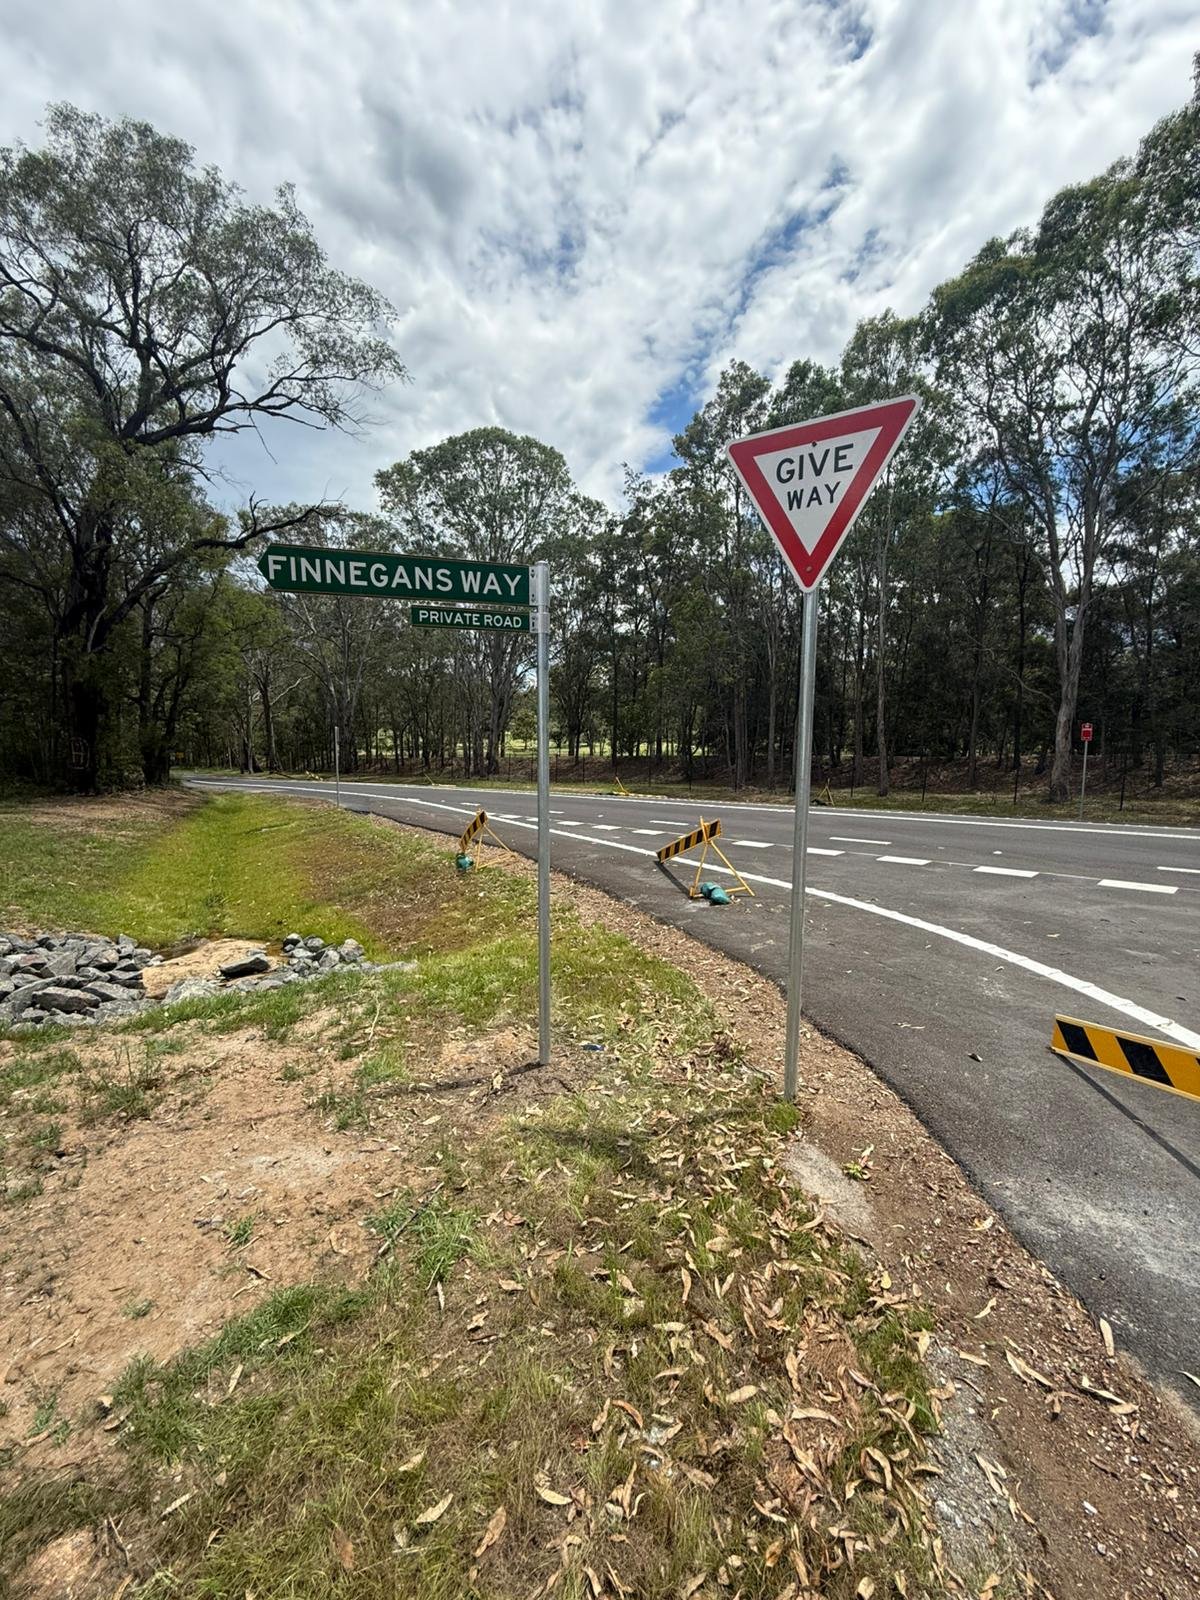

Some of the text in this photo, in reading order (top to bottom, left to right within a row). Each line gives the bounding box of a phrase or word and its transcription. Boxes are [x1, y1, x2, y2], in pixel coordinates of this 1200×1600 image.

[776, 443, 854, 484] GIVE
[787, 481, 841, 511] WAY
[267, 554, 522, 596] FINNEGANS WAY
[419, 610, 522, 628] PRIVATE ROAD
